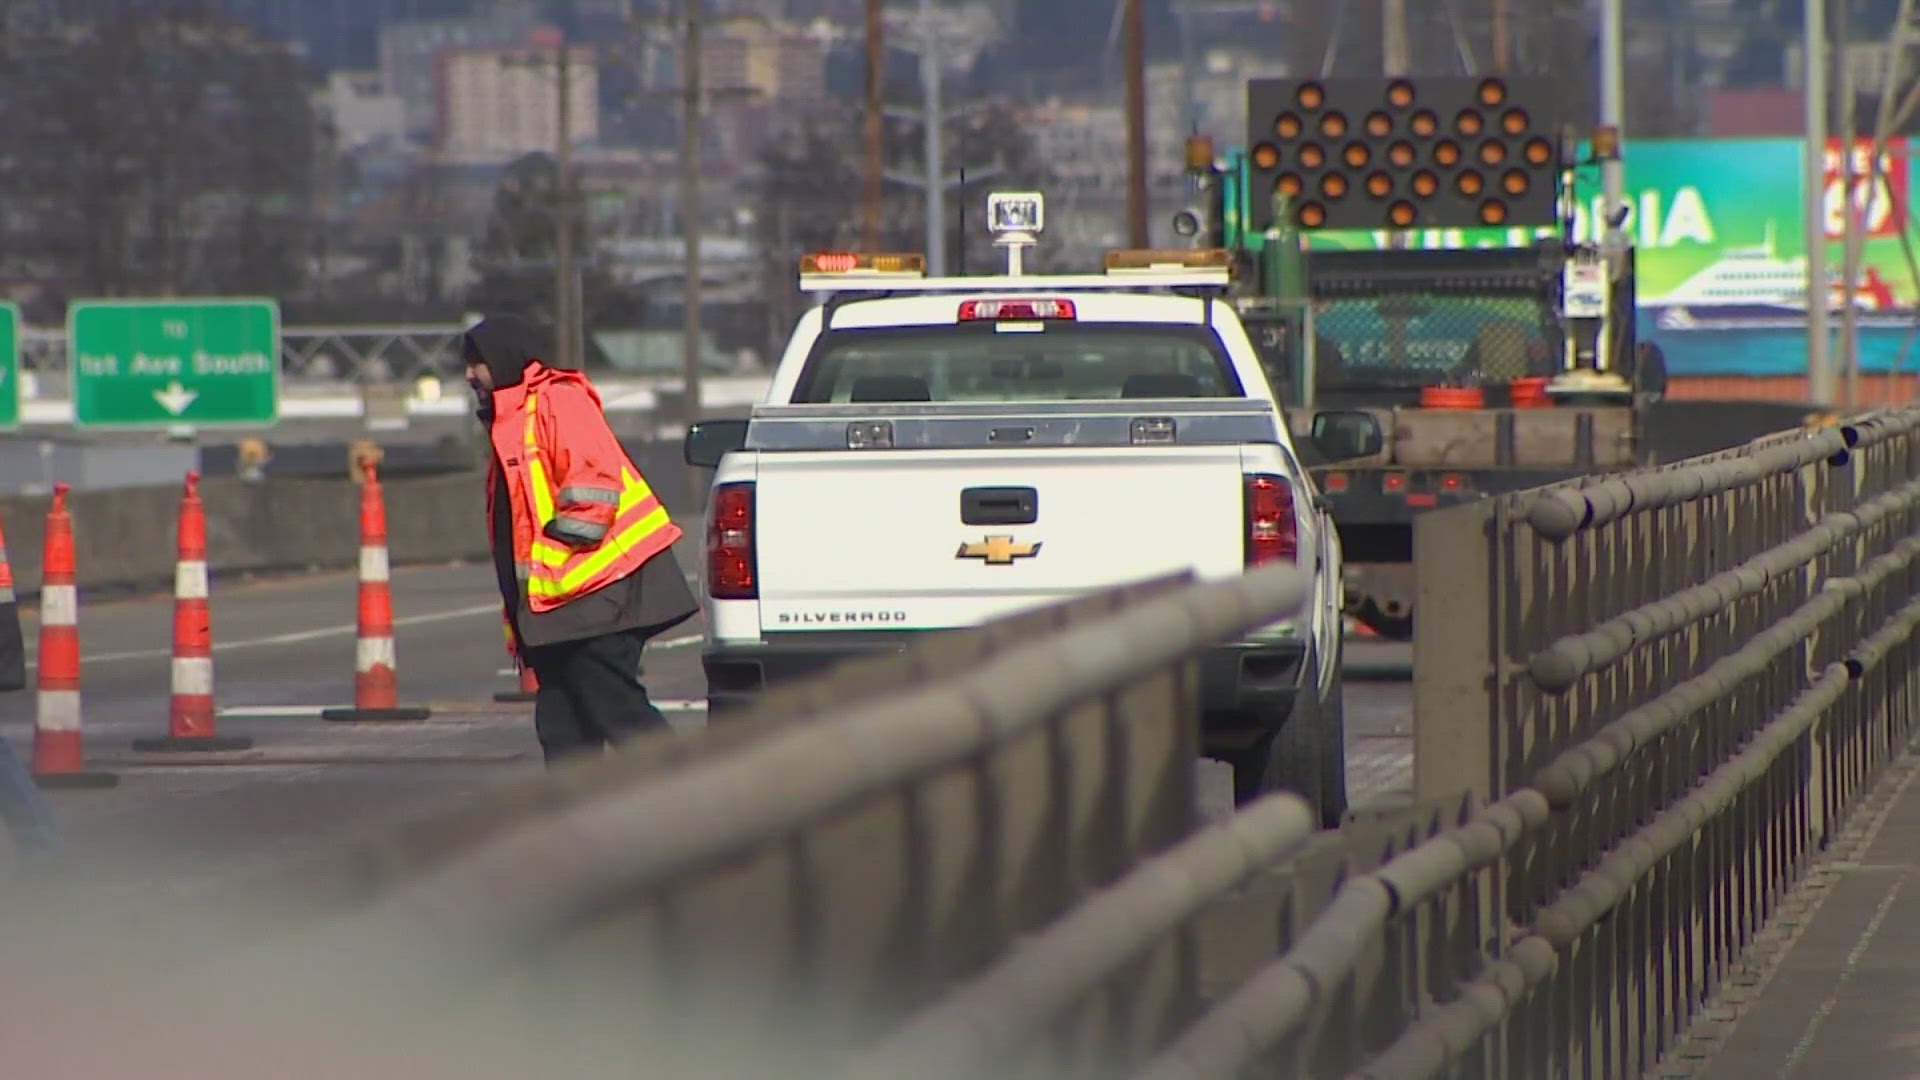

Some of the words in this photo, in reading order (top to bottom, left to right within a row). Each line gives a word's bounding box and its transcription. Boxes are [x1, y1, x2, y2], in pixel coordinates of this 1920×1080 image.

[162, 320, 188, 339] TO
[129, 353, 182, 374] Ave
[193, 352, 270, 374] South
[779, 611, 907, 623] SILVERADO
